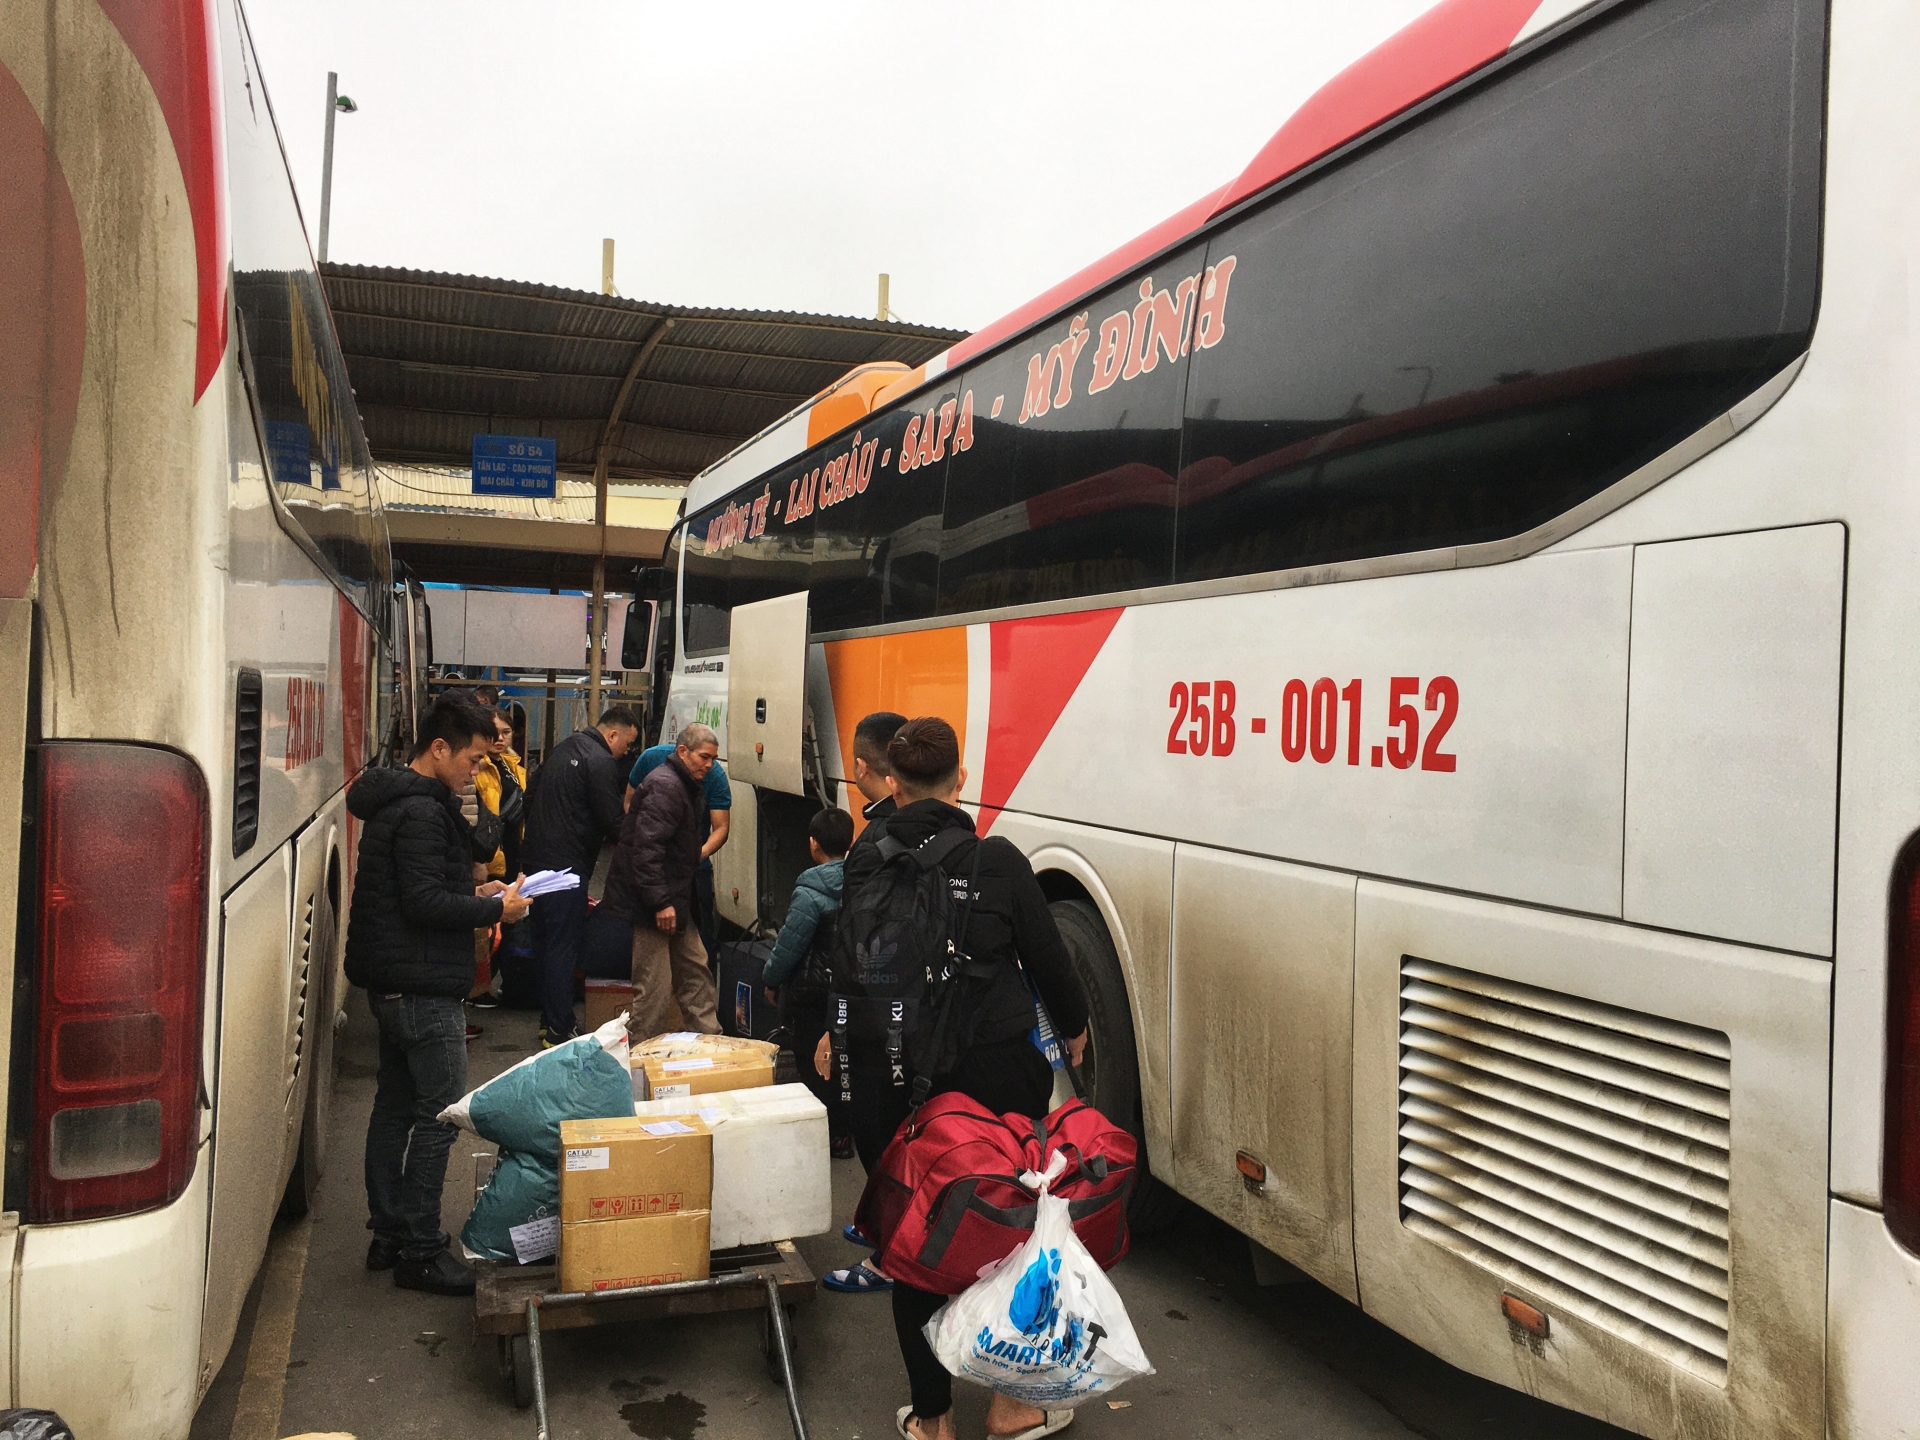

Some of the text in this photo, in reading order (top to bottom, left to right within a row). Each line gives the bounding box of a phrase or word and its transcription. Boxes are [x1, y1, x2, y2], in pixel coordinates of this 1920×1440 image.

[784, 467, 820, 524] LAI
[818, 431, 879, 509] CHÂU
[899, 389, 974, 474] SAPA
[1018, 311, 1090, 424] MỸ
[1088, 254, 1237, 395] ĐÌNH
[528, 445, 543, 457] 54
[1167, 680, 1236, 757] 25B
[1281, 675, 1459, 773] 001.52
[852, 970, 899, 985] adidas
